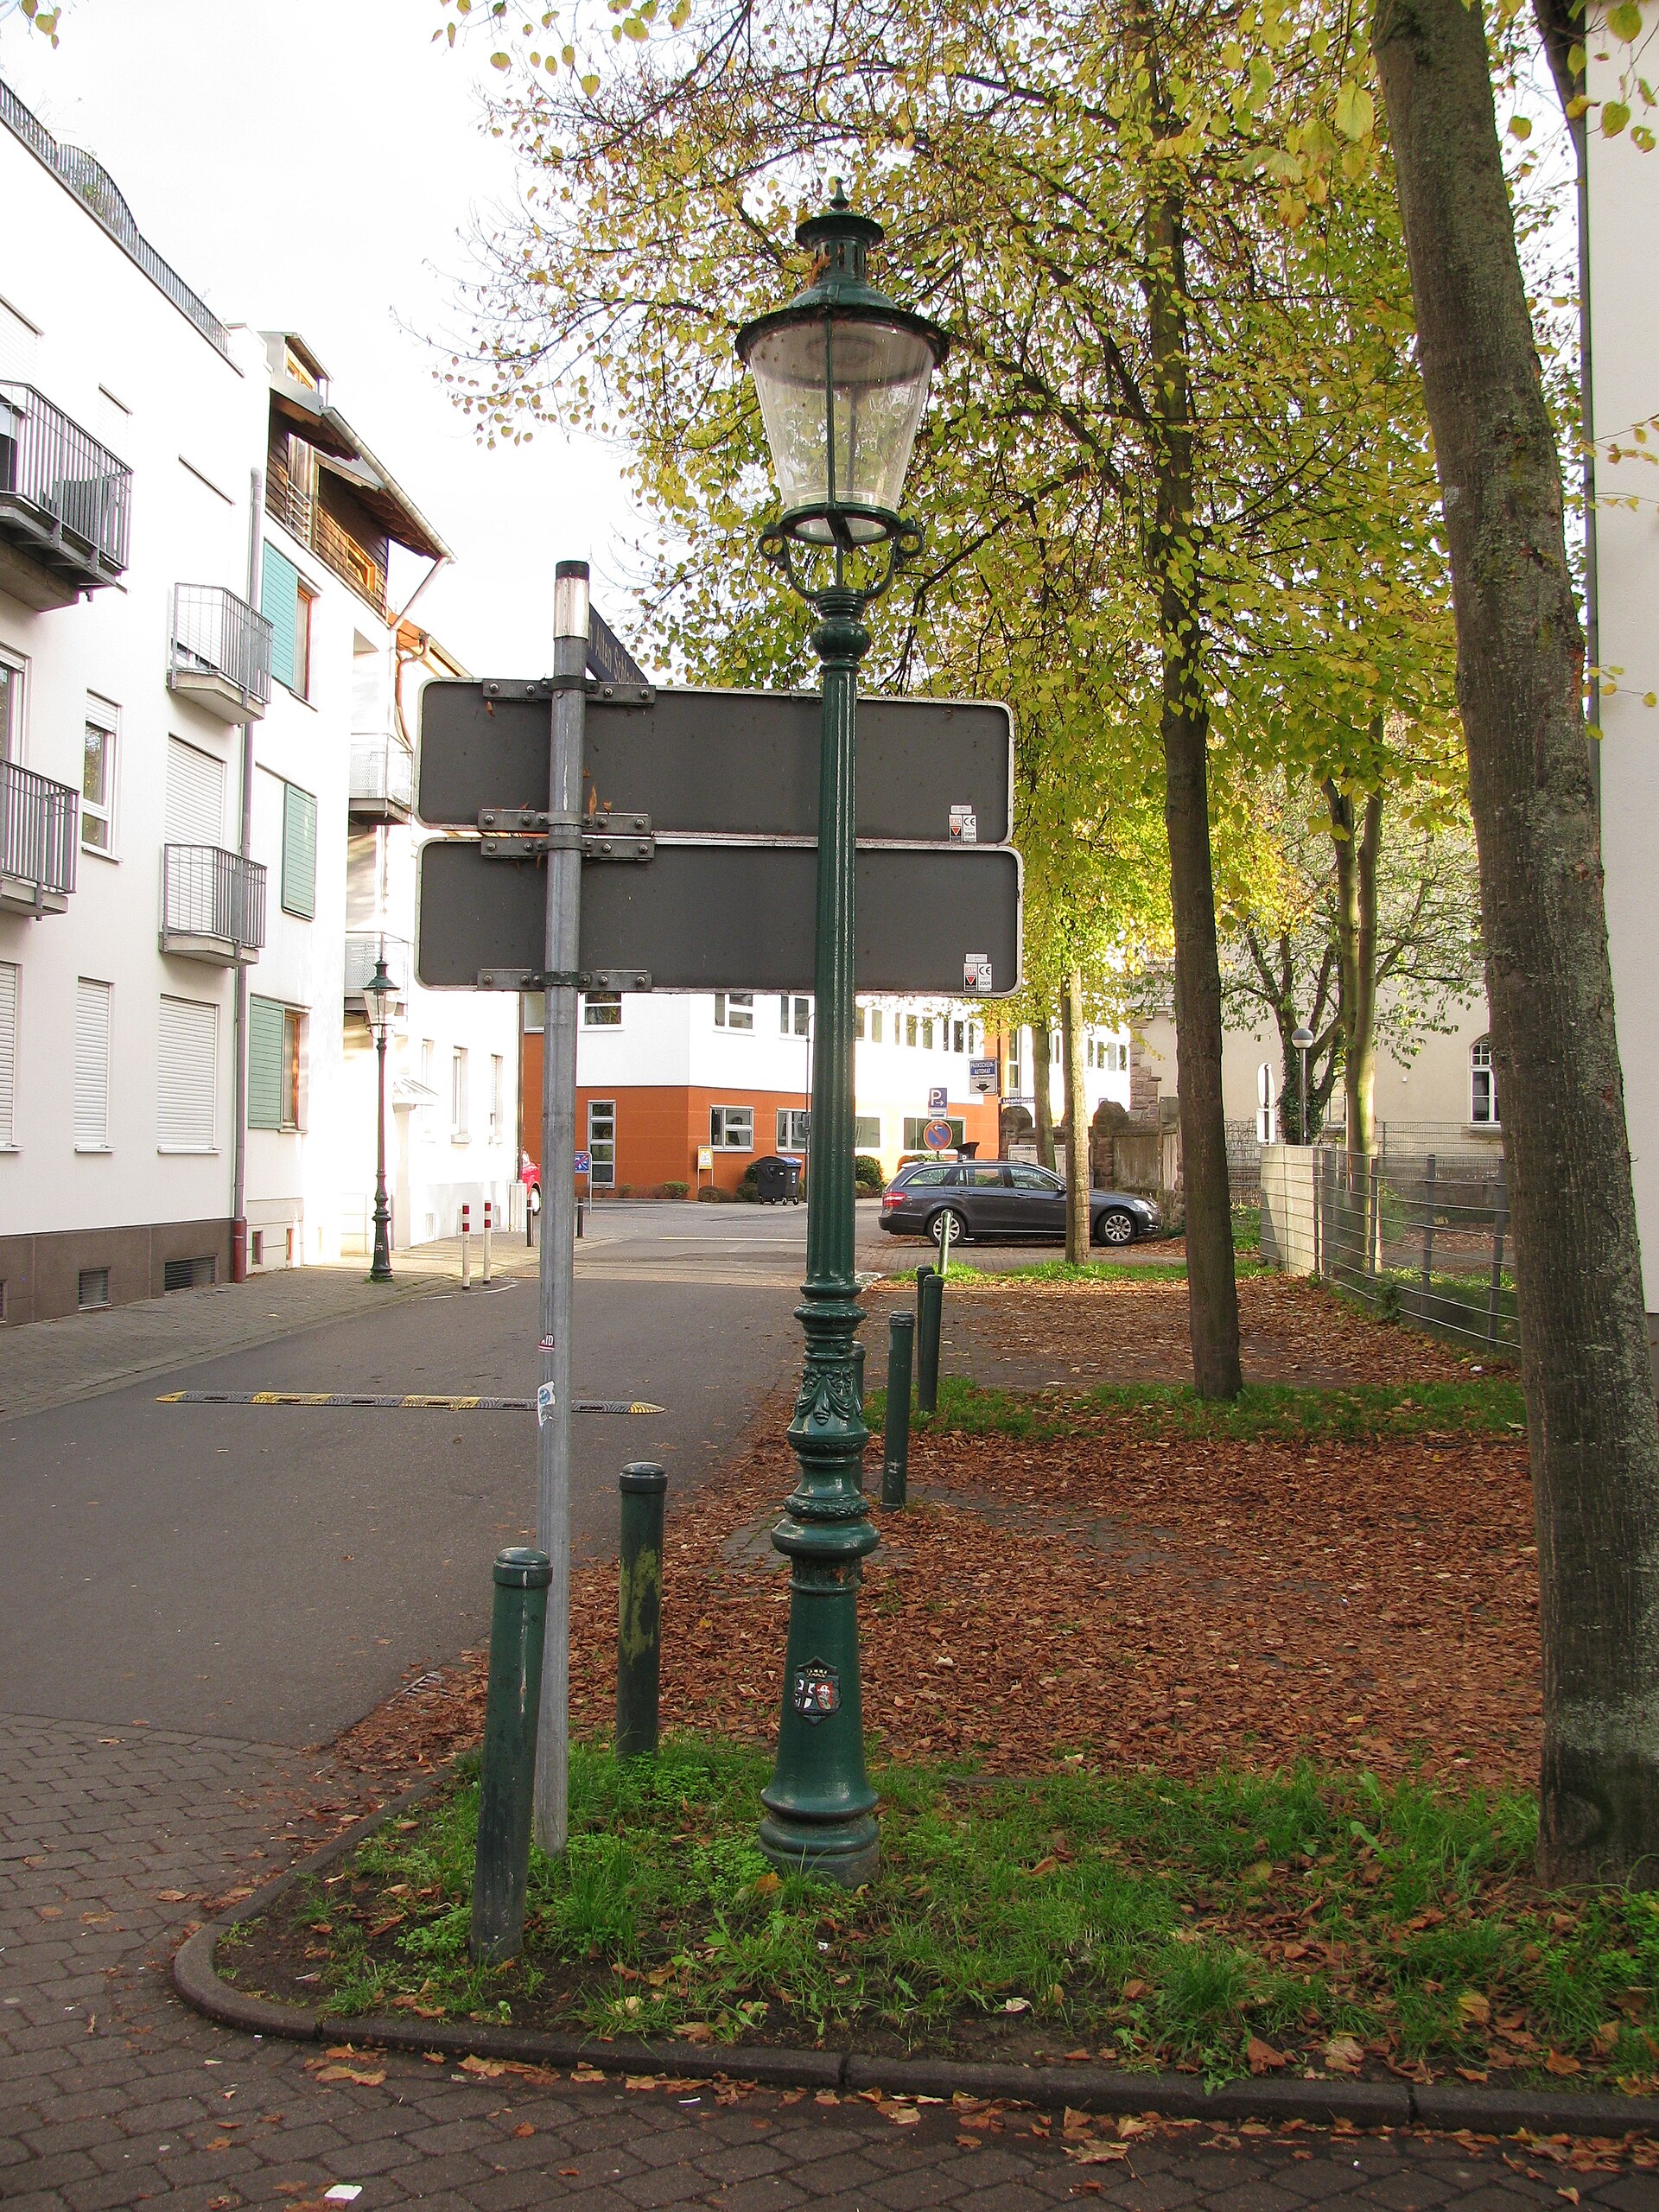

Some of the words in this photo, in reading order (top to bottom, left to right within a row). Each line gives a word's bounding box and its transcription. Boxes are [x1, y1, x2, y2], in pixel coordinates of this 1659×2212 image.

[963, 817, 975, 826] CE
[979, 966, 990, 975] CE
[931, 1090, 942, 1106] P
